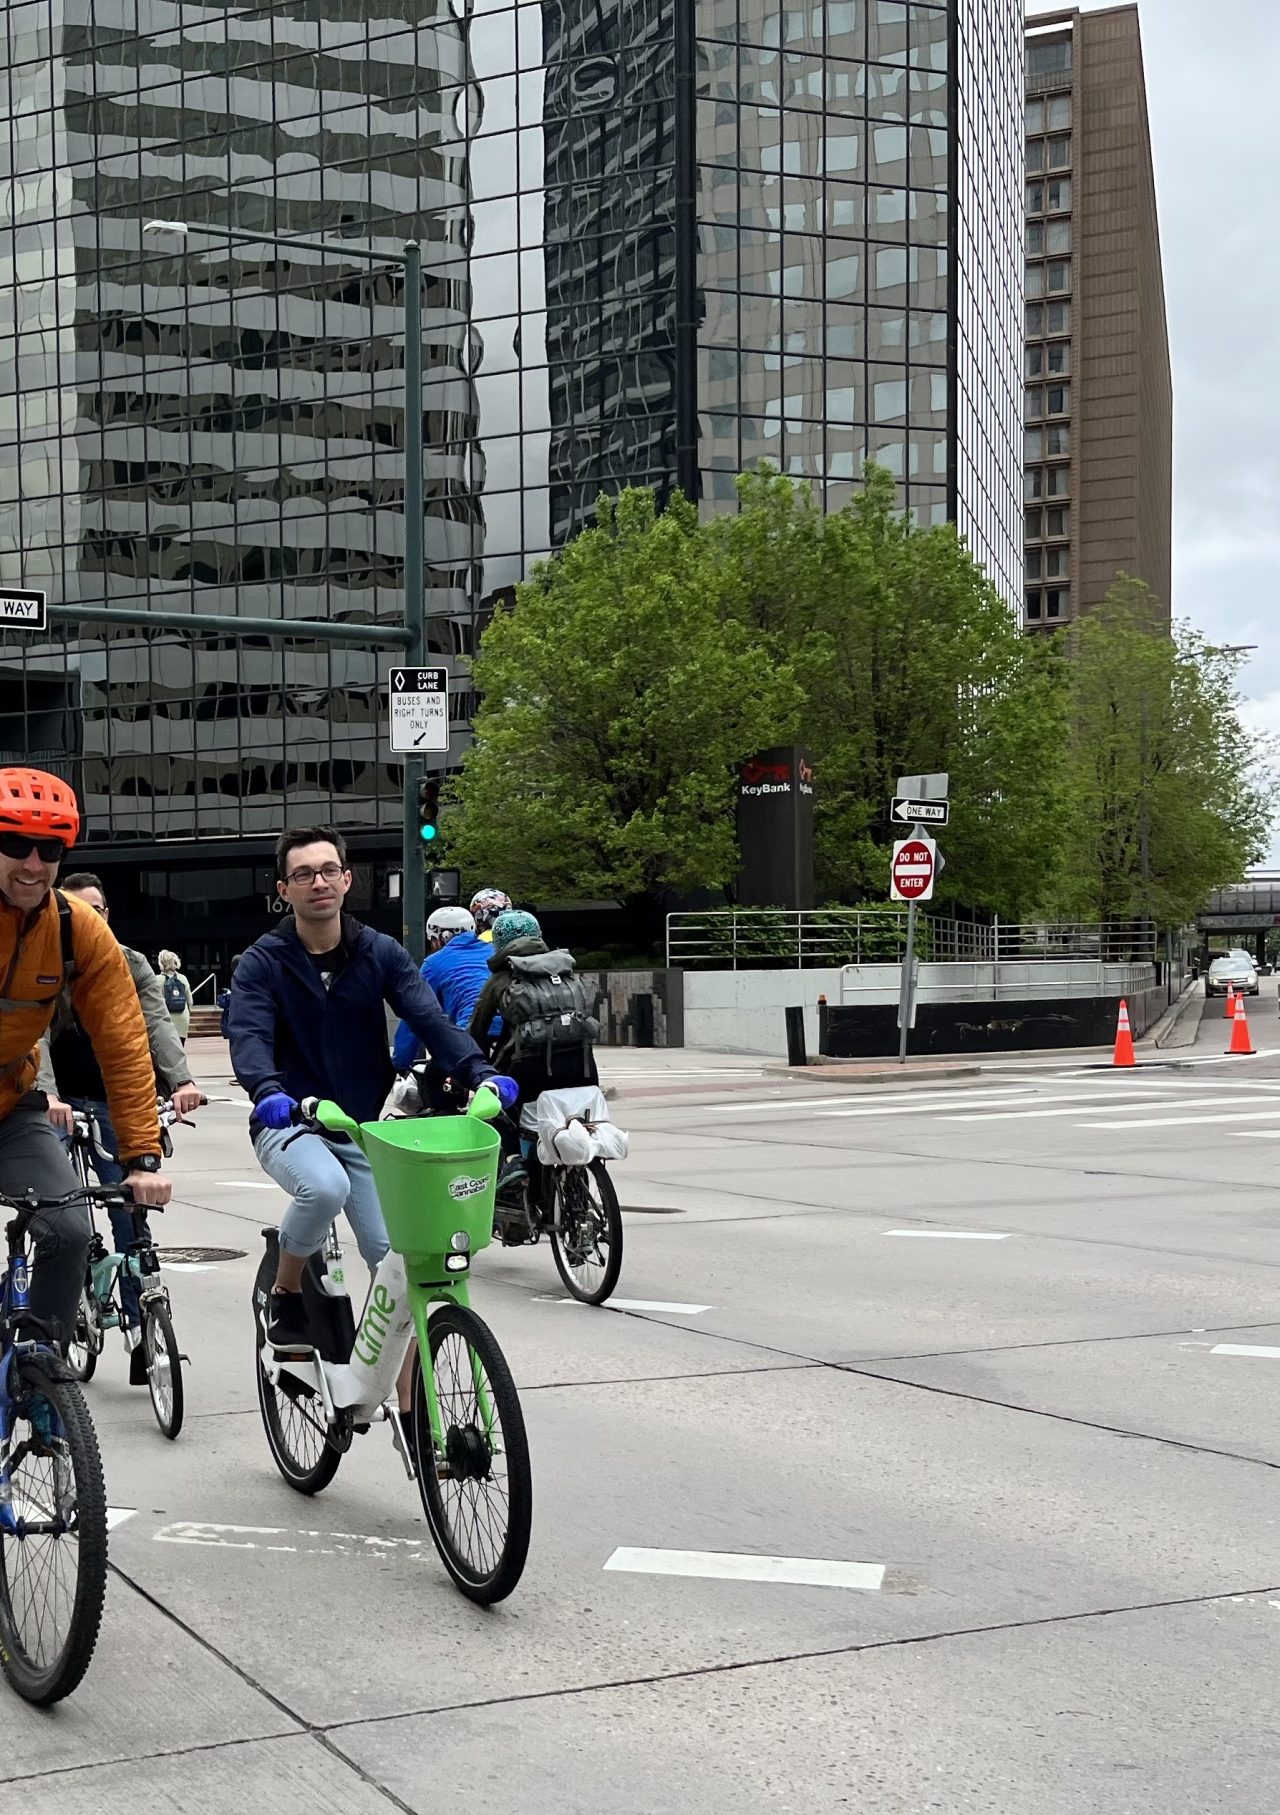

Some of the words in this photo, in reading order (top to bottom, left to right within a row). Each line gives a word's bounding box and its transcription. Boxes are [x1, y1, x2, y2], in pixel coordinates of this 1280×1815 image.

[4, 601, 33, 616] WAY
[417, 671, 439, 680] CURB
[417, 681, 439, 690] LANE
[397, 696, 421, 706] BUSES
[426, 696, 441, 705] AND
[394, 708, 415, 717] RIGHT
[421, 707, 444, 717] TURNS
[410, 720, 428, 729] ONLY
[741, 782, 791, 796] KeyBank
[906, 806, 923, 816] ONE
[925, 807, 942, 817] WAY
[900, 852, 910, 862] DO
[913, 852, 928, 862] NOT
[900, 878, 924, 888] ENTER
[354, 1284, 396, 1366] Lime
